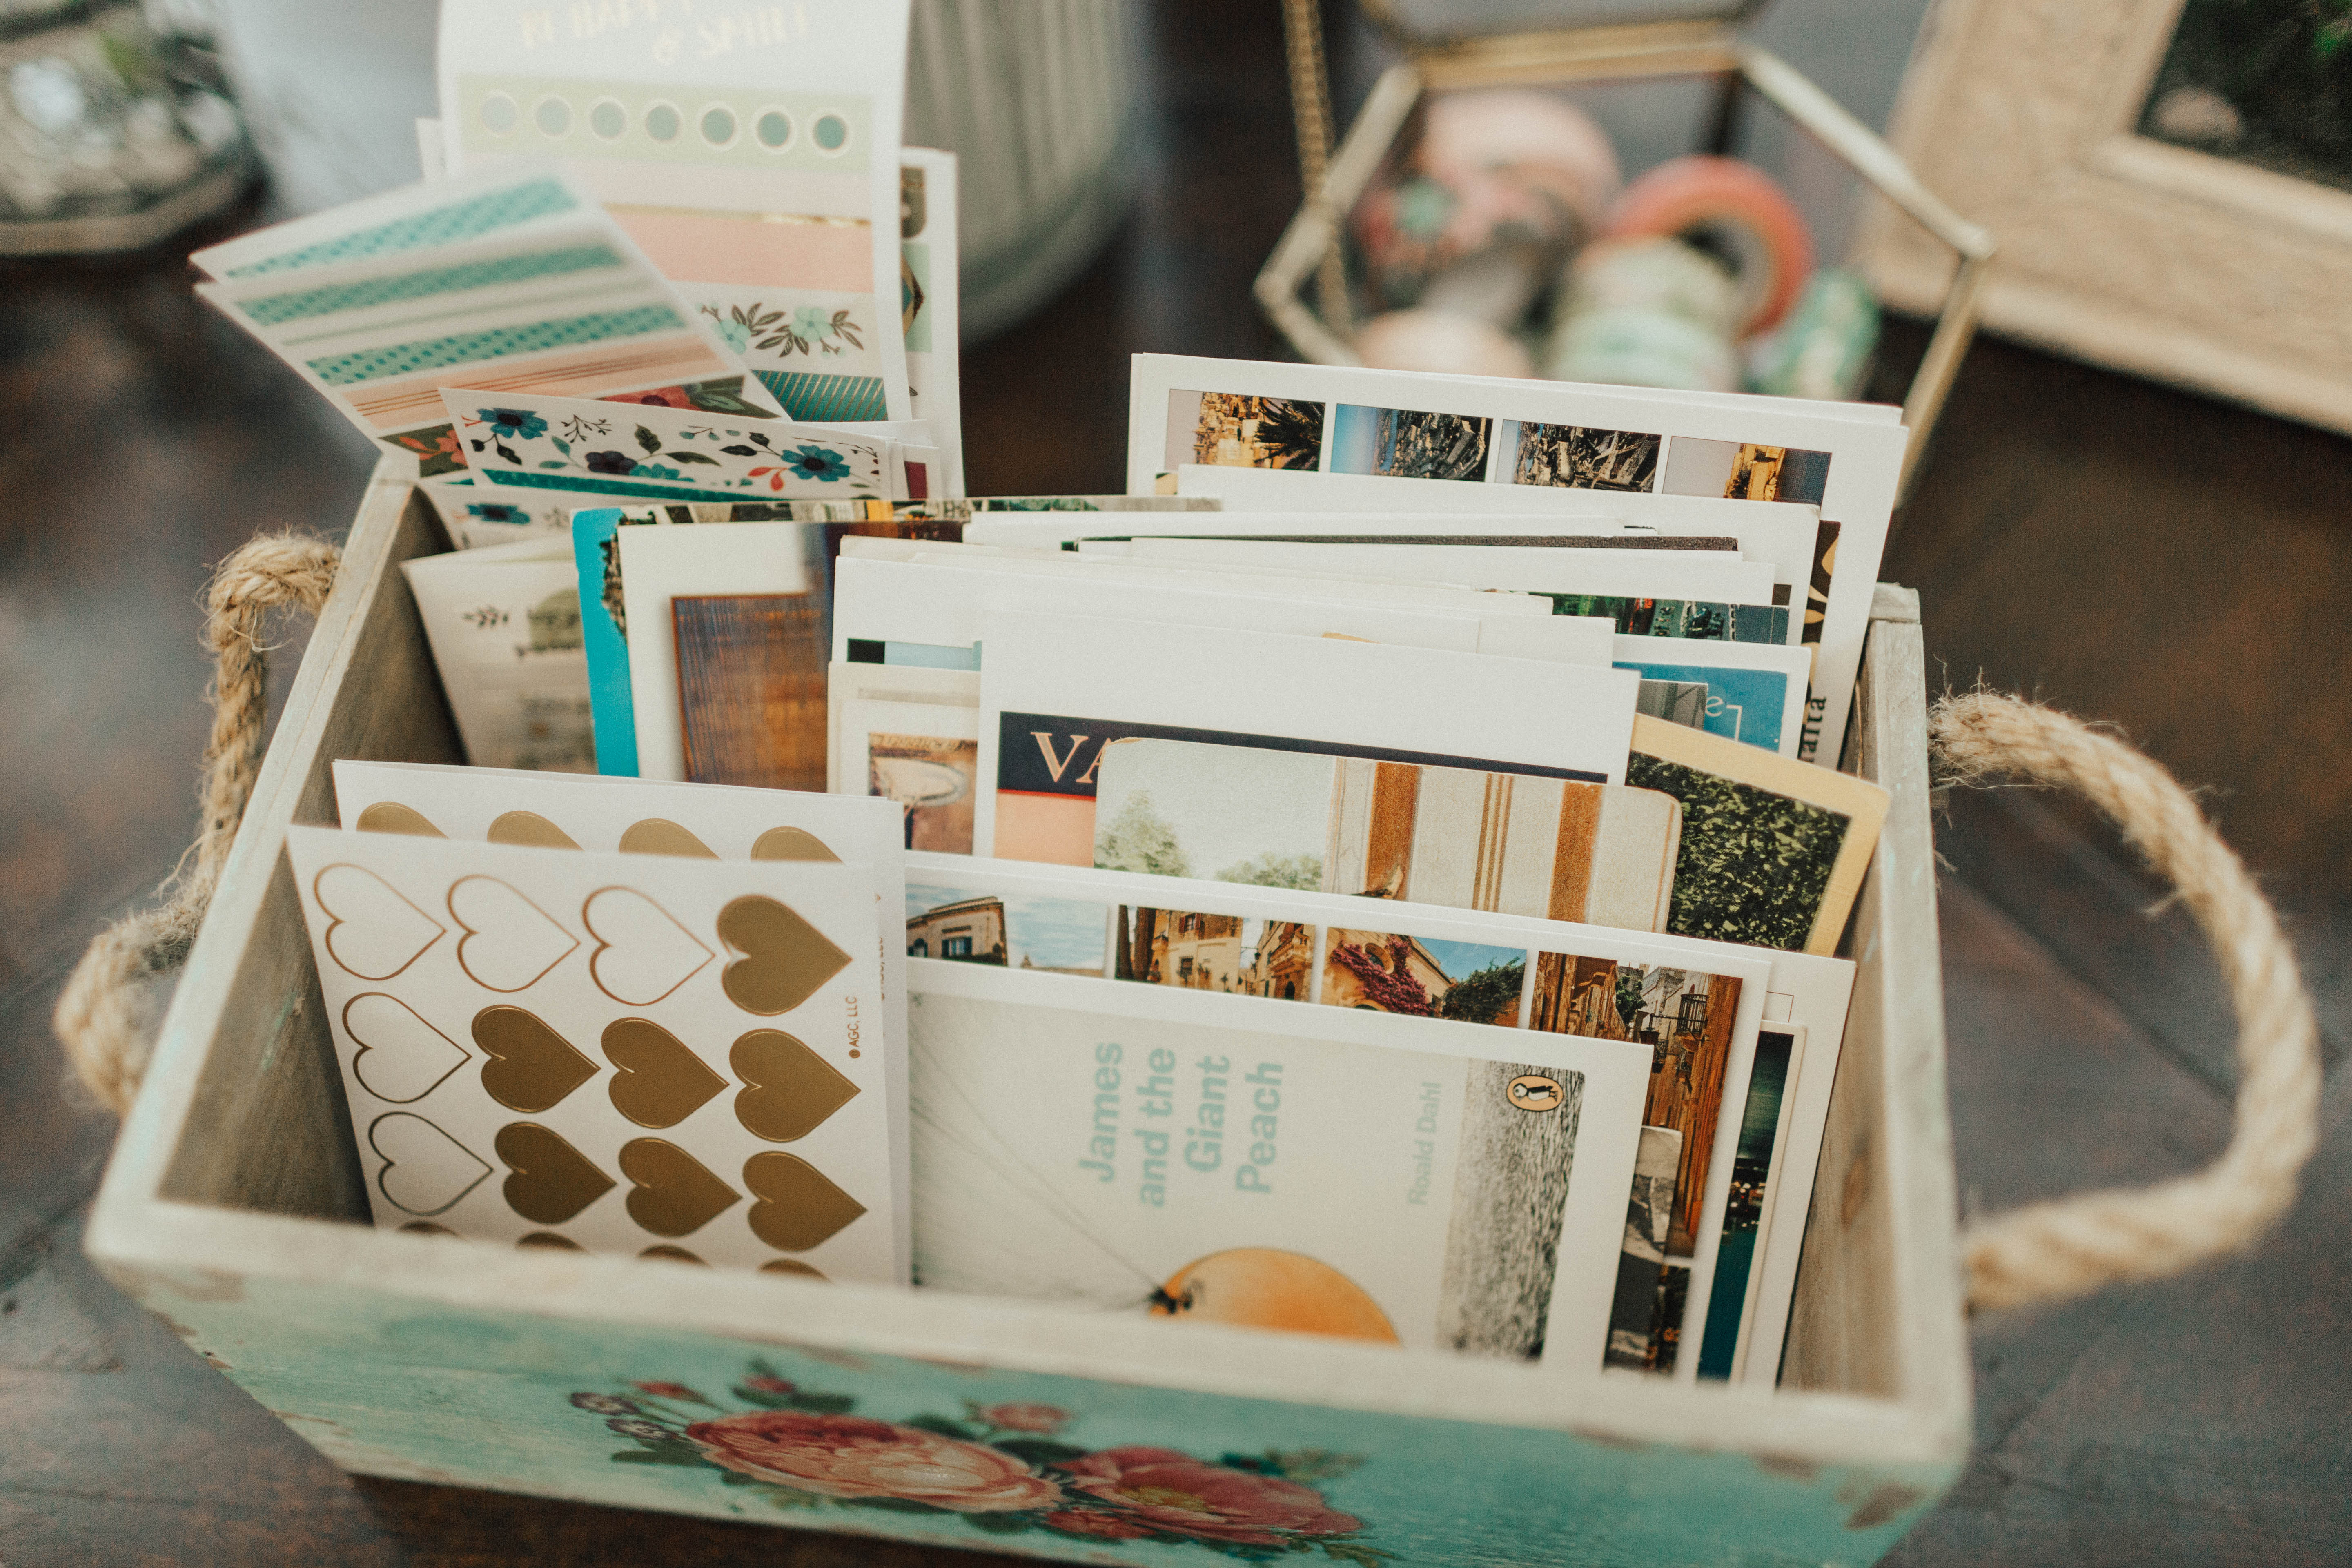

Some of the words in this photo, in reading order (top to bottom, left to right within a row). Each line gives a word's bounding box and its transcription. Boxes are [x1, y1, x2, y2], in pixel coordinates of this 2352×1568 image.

[1799, 697, 1826, 762] alta
[845, 996, 858, 1017] LLC
[1078, 1042, 1123, 1183] James
[1136, 1048, 1176, 1118] the
[1184, 1055, 1231, 1173] Giant
[1416, 1082, 1441, 1133] Dahl
[1236, 1062, 1283, 1195] Peach
[1133, 1129, 1170, 1208] and
[1408, 1140, 1433, 1205] Roald
